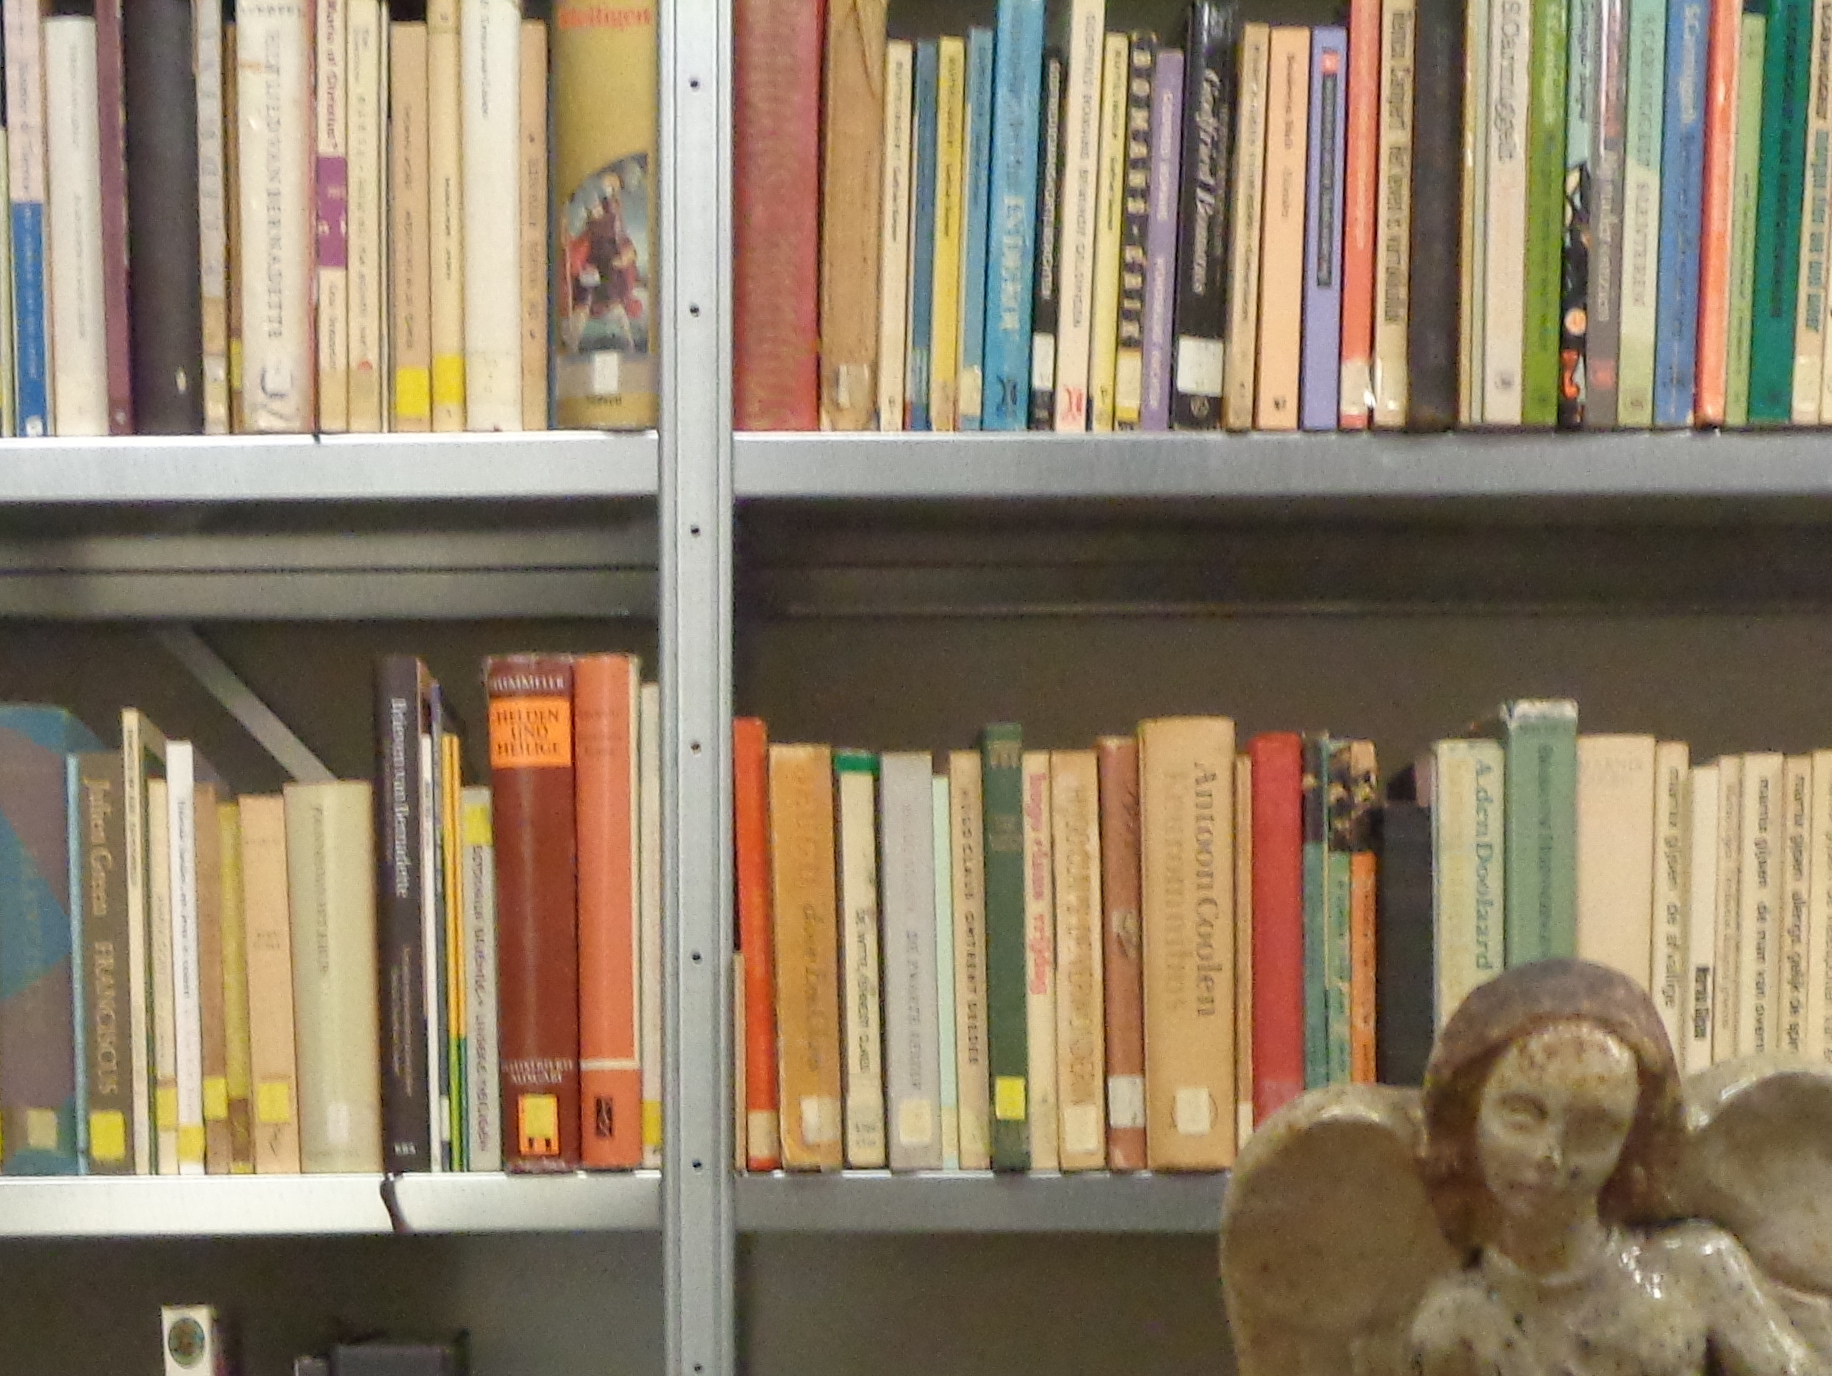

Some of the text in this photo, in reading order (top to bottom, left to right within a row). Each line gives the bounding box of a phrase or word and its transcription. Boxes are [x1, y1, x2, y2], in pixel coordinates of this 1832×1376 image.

[495, 709, 561, 726] HELDEN
[963, 843, 975, 899] CLAUS
[1193, 761, 1223, 1017] Antoon Coolen
[1475, 843, 1495, 970] Doolaard
[1755, 838, 1769, 887] gijsen
[94, 942, 119, 1094] FRANCISCUS
